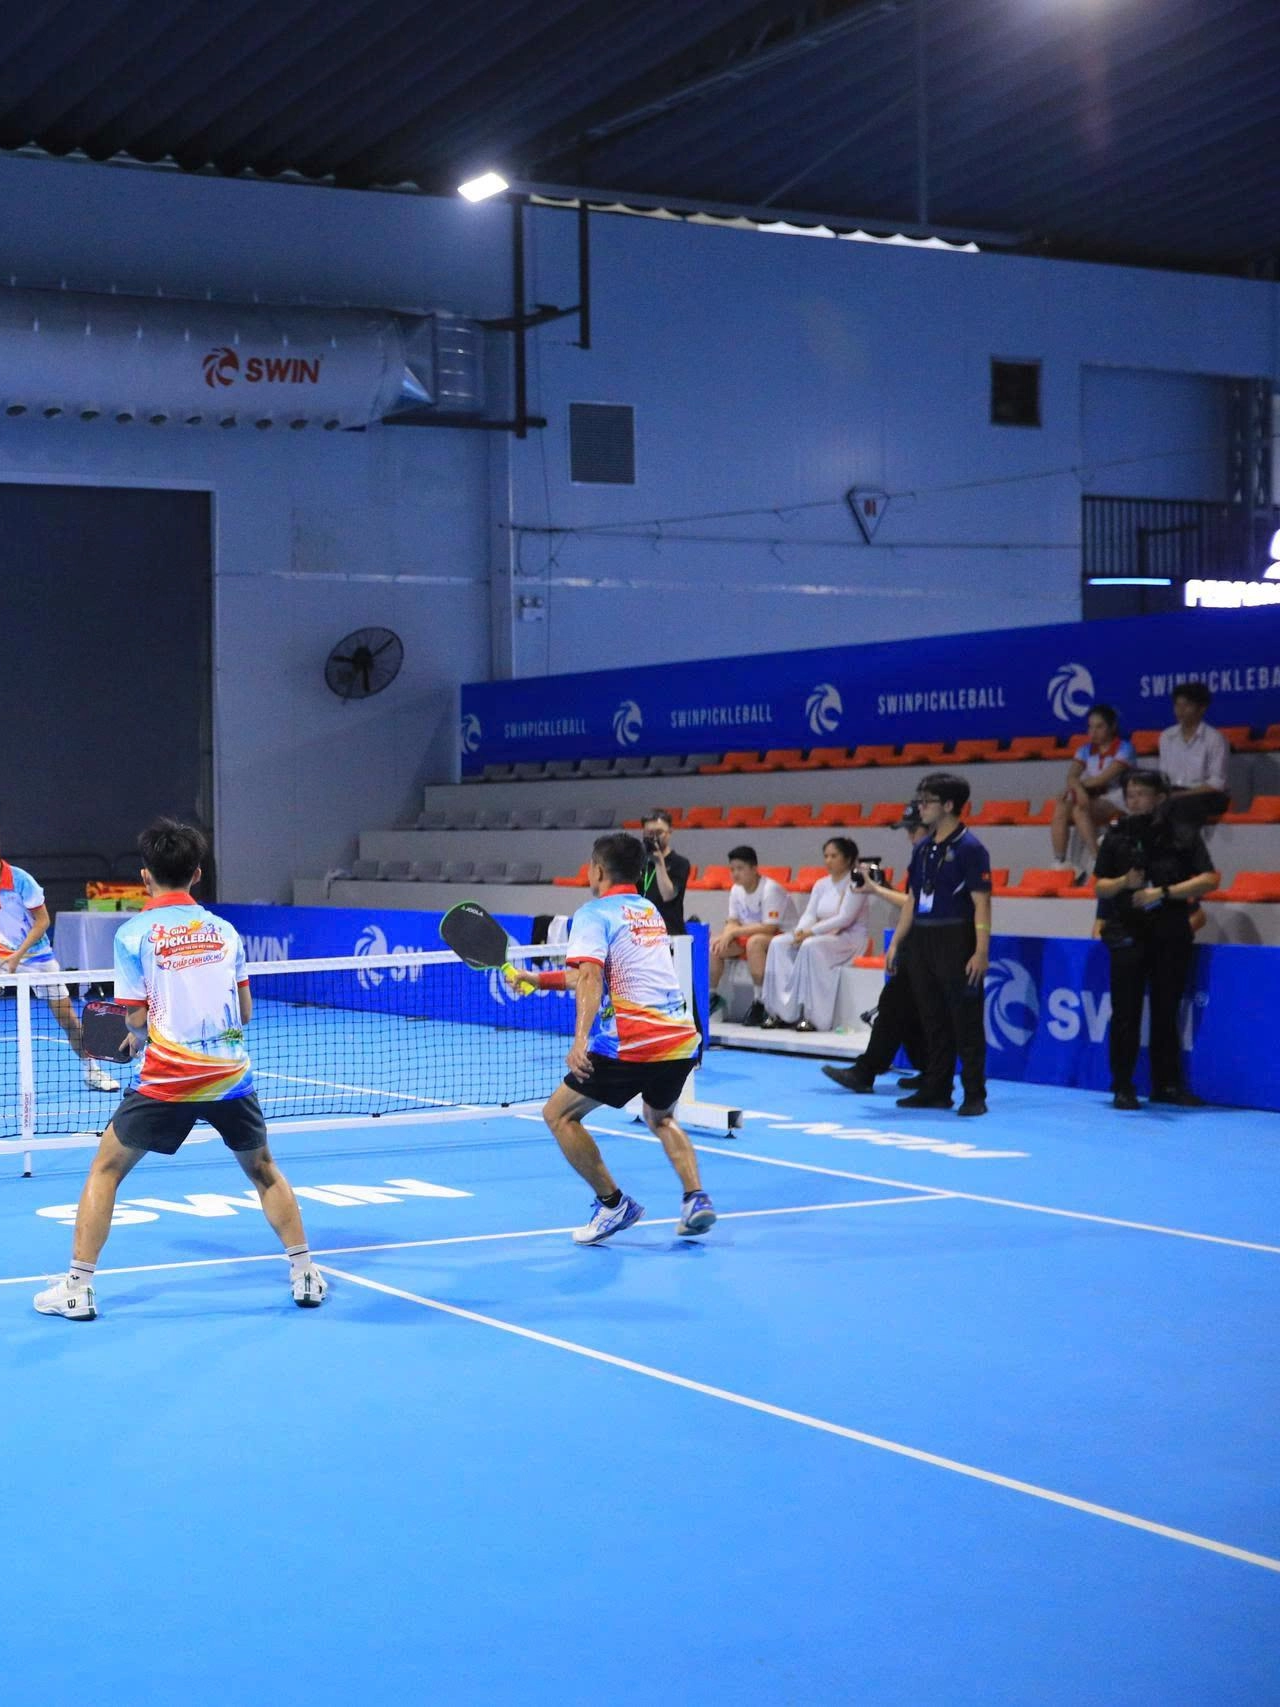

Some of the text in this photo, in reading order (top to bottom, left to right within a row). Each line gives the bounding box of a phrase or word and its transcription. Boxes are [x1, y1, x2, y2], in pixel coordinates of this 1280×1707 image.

[245, 357, 320, 384] SWIN
[877, 687, 1006, 716] SWINPICKLEBALL
[504, 719, 587, 740] SWINPICKLEBALL
[670, 704, 773, 729] SWINPICKLEBALL
[155, 933, 224, 956] PICKLEBALL
[36, 1178, 475, 1227] SWIN
